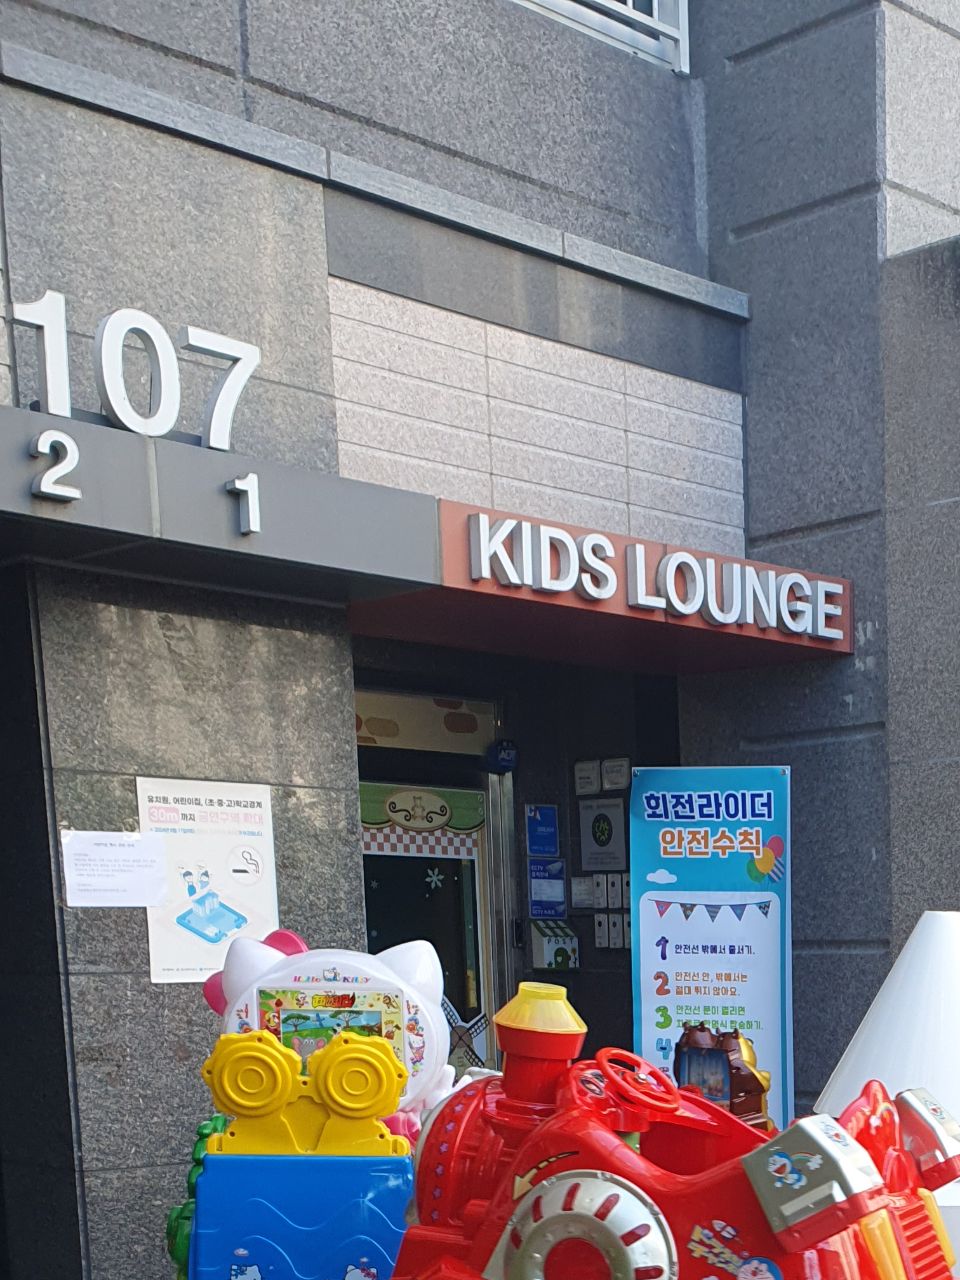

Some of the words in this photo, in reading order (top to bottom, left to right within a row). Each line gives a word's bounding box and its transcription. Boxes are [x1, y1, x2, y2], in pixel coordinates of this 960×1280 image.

[12, 289, 261, 450] 107
[33, 429, 83, 500] 2
[228, 472, 261, 534] 1
[470, 512, 618, 601] KIDS
[627, 543, 844, 641] LOUNGE
[644, 791, 773, 820] 회전라이더
[661, 828, 762, 857] 안전수칙
[655, 936, 669, 961] 1
[674, 944, 699, 955] 안전선
[701, 944, 726, 955] 밖에서
[653, 971, 671, 996] 2
[675, 971, 699, 982] 안전선
[715, 972, 748, 983] 밖에서는
[655, 1005, 673, 1029] 3
[676, 1005, 700, 1015] 안전선
